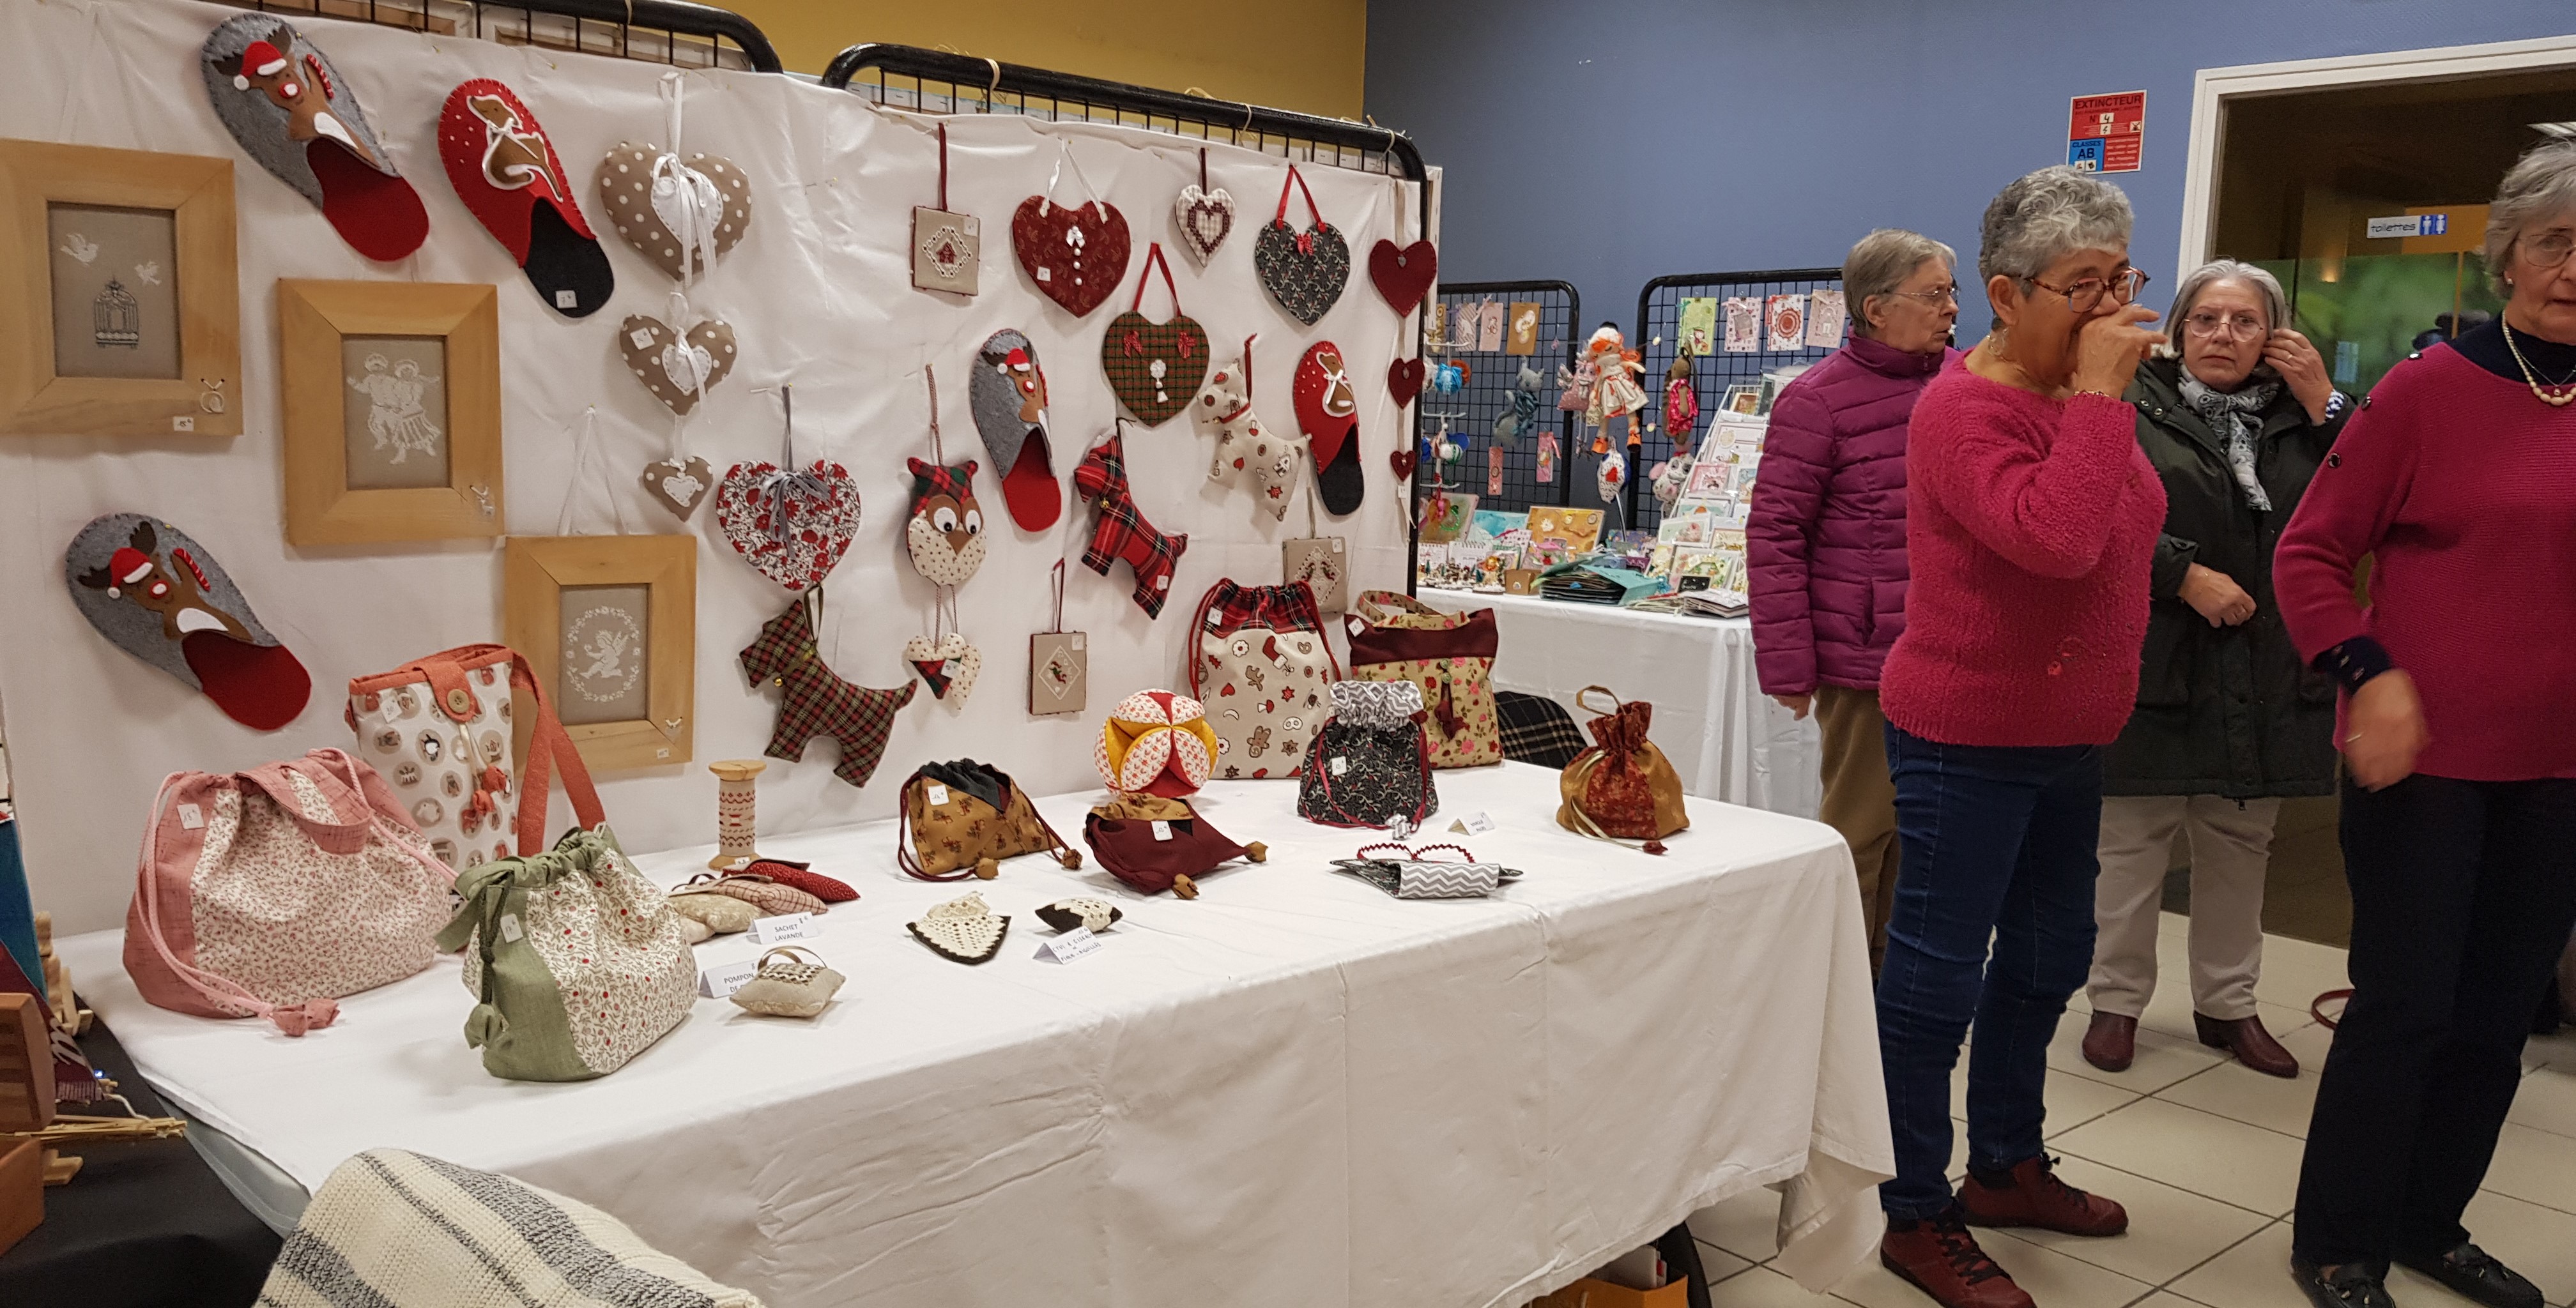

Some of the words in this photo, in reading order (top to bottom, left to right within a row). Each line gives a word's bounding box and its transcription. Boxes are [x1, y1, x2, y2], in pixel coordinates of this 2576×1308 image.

[2075, 95, 2141, 109] EXTINCTEUR
[2078, 148, 2094, 159] AB
[2371, 224, 2416, 232] toilettes
[774, 924, 798, 933] SACHET
[774, 932, 803, 941] LAVANDE
[723, 972, 754, 984] POMPON
